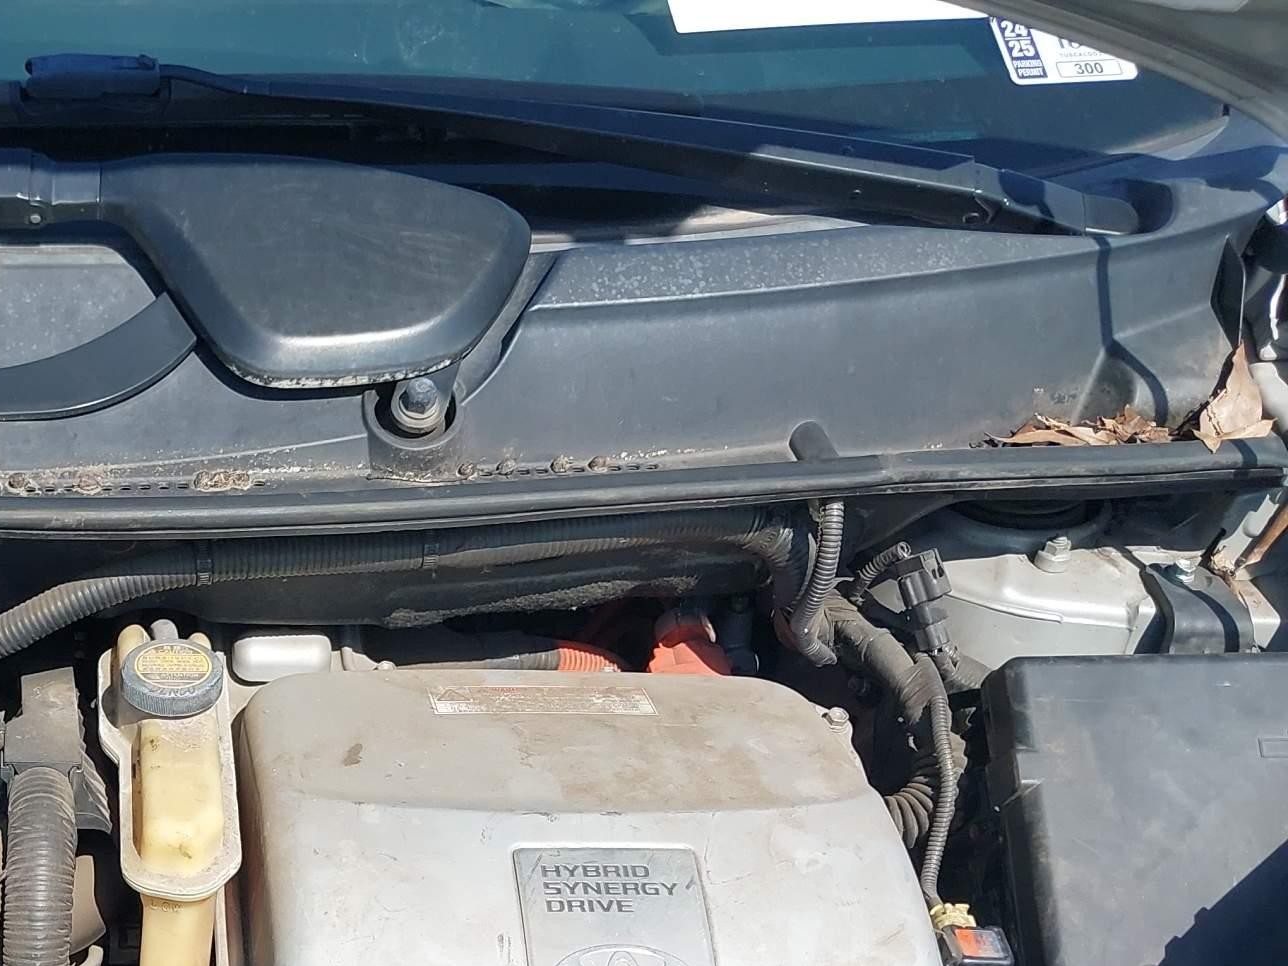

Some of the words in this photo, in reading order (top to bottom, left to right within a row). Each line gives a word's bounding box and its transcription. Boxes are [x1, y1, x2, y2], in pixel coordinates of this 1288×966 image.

[1000, 20, 1028, 38] 24
[1008, 39, 1036, 58] 25
[1018, 67, 1044, 78] PERMIT
[1073, 62, 1104, 75] 300
[540, 864, 650, 878] HYBRID
[542, 881, 679, 896] SYNERGY
[150, 899, 184, 912] LOW
[545, 899, 635, 913] DRIVE
